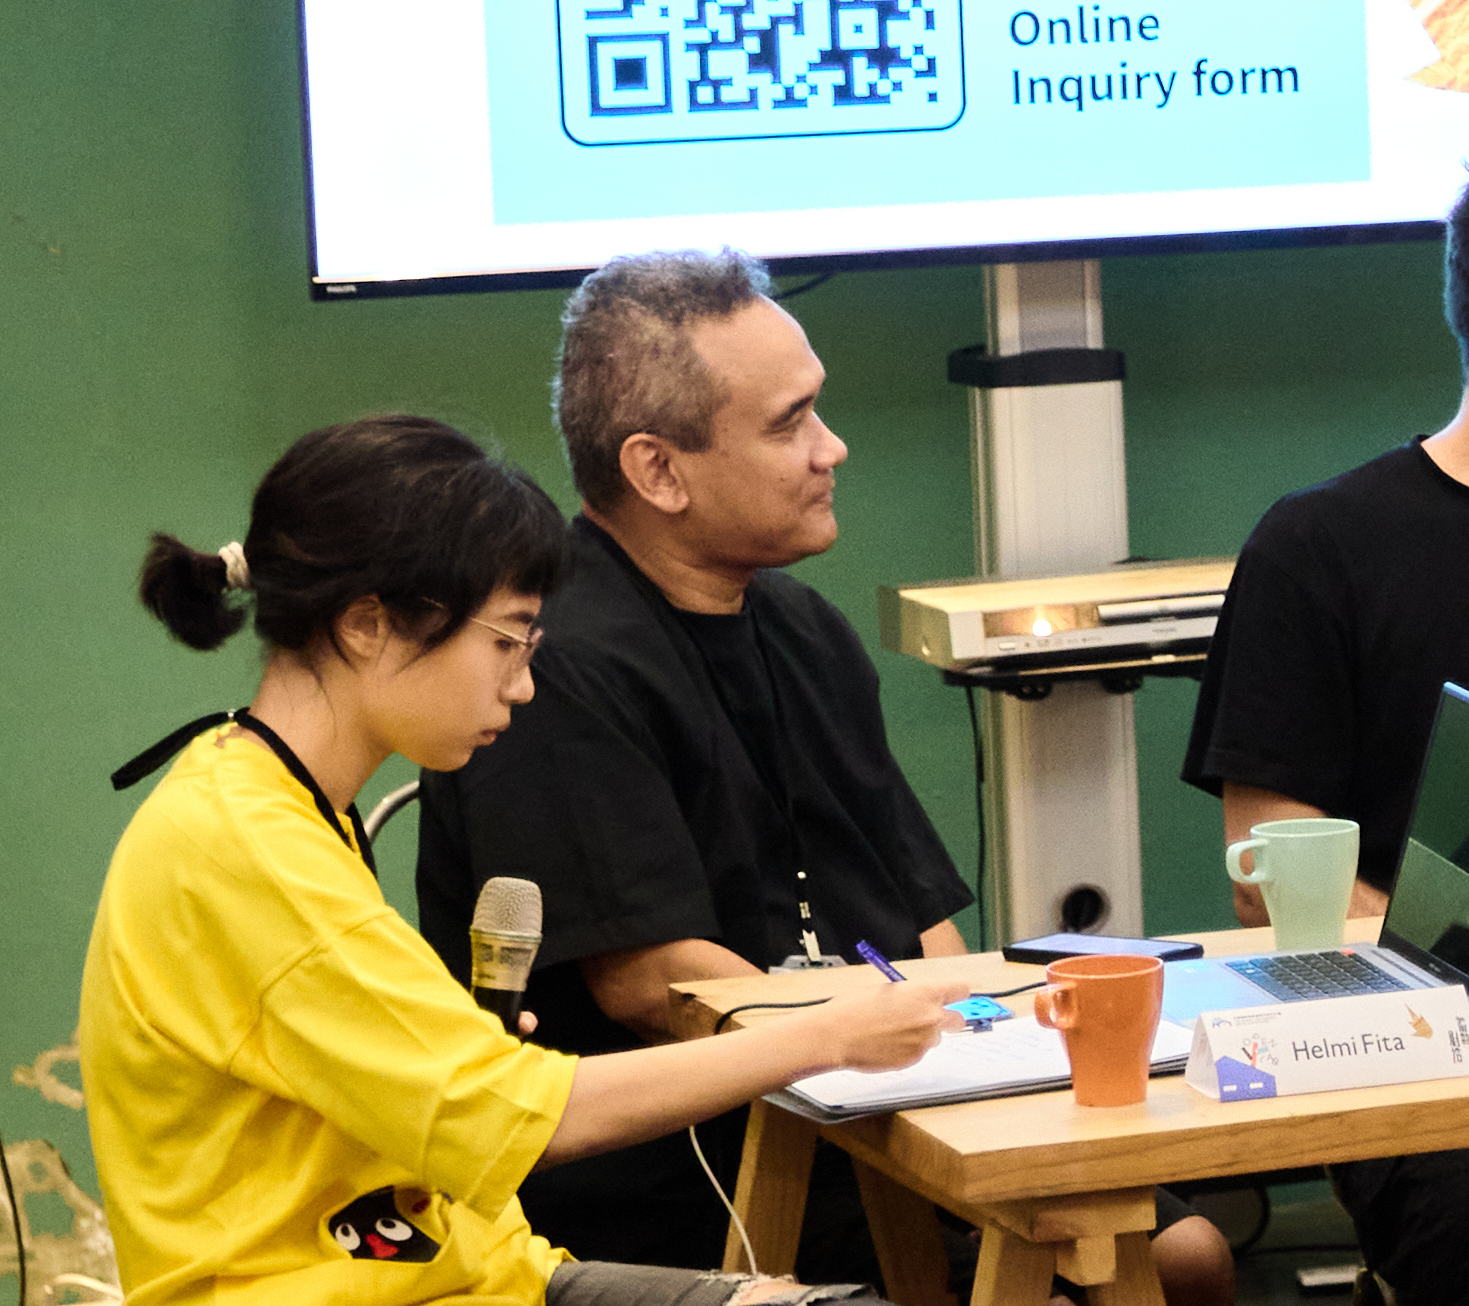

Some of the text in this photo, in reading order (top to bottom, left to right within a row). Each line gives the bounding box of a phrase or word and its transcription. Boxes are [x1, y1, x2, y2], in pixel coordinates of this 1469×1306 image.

[1009, 5, 1161, 46] Online
[1012, 57, 1302, 112] Inquiry form
[1292, 1033, 1405, 1061] Helmi Fita
